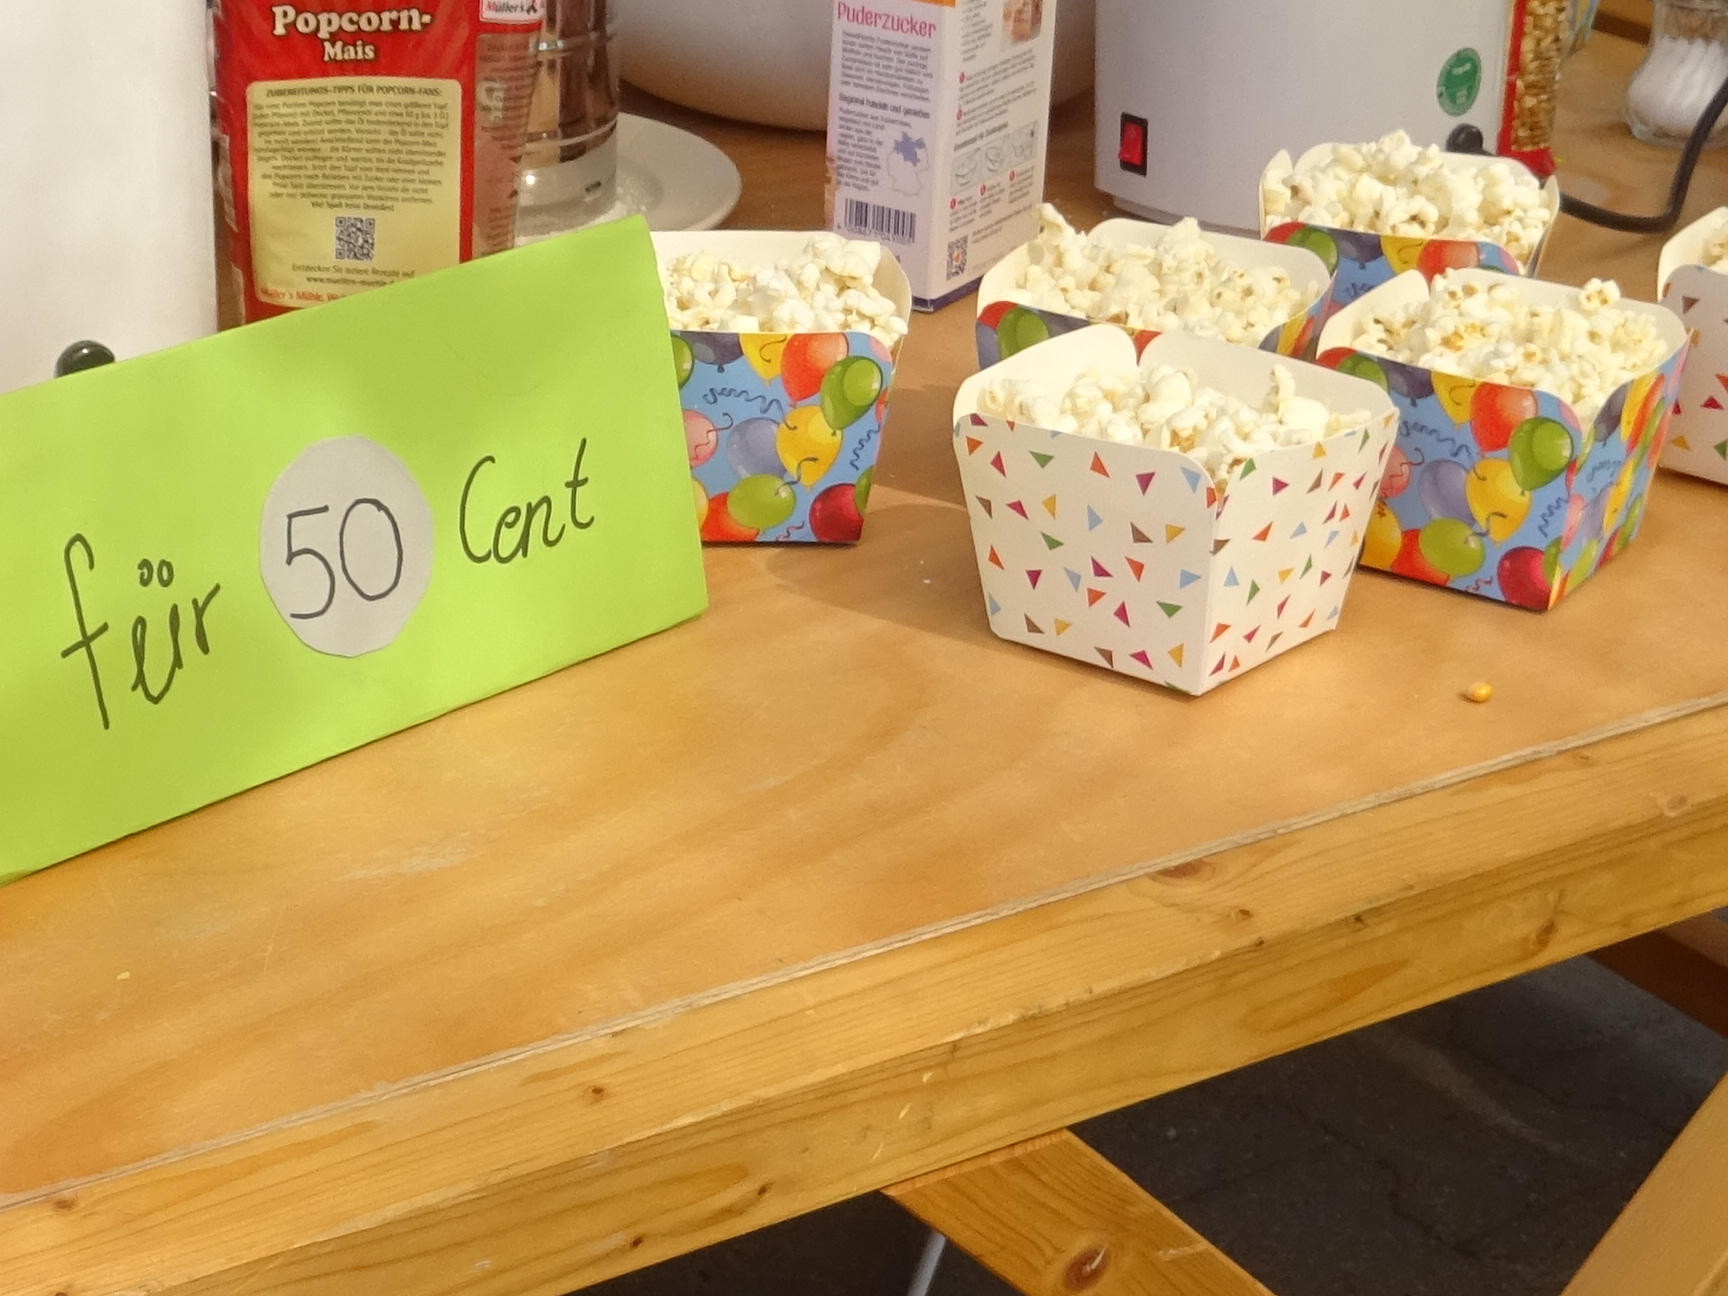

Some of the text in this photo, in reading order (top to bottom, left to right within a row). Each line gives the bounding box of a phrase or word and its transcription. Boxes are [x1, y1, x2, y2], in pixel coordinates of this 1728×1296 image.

[271, 4, 433, 40] Popcorn-
[837, 1, 937, 38] Puderzucker
[323, 39, 377, 62] Mais
[59, 436, 597, 730] für 50 Cent
